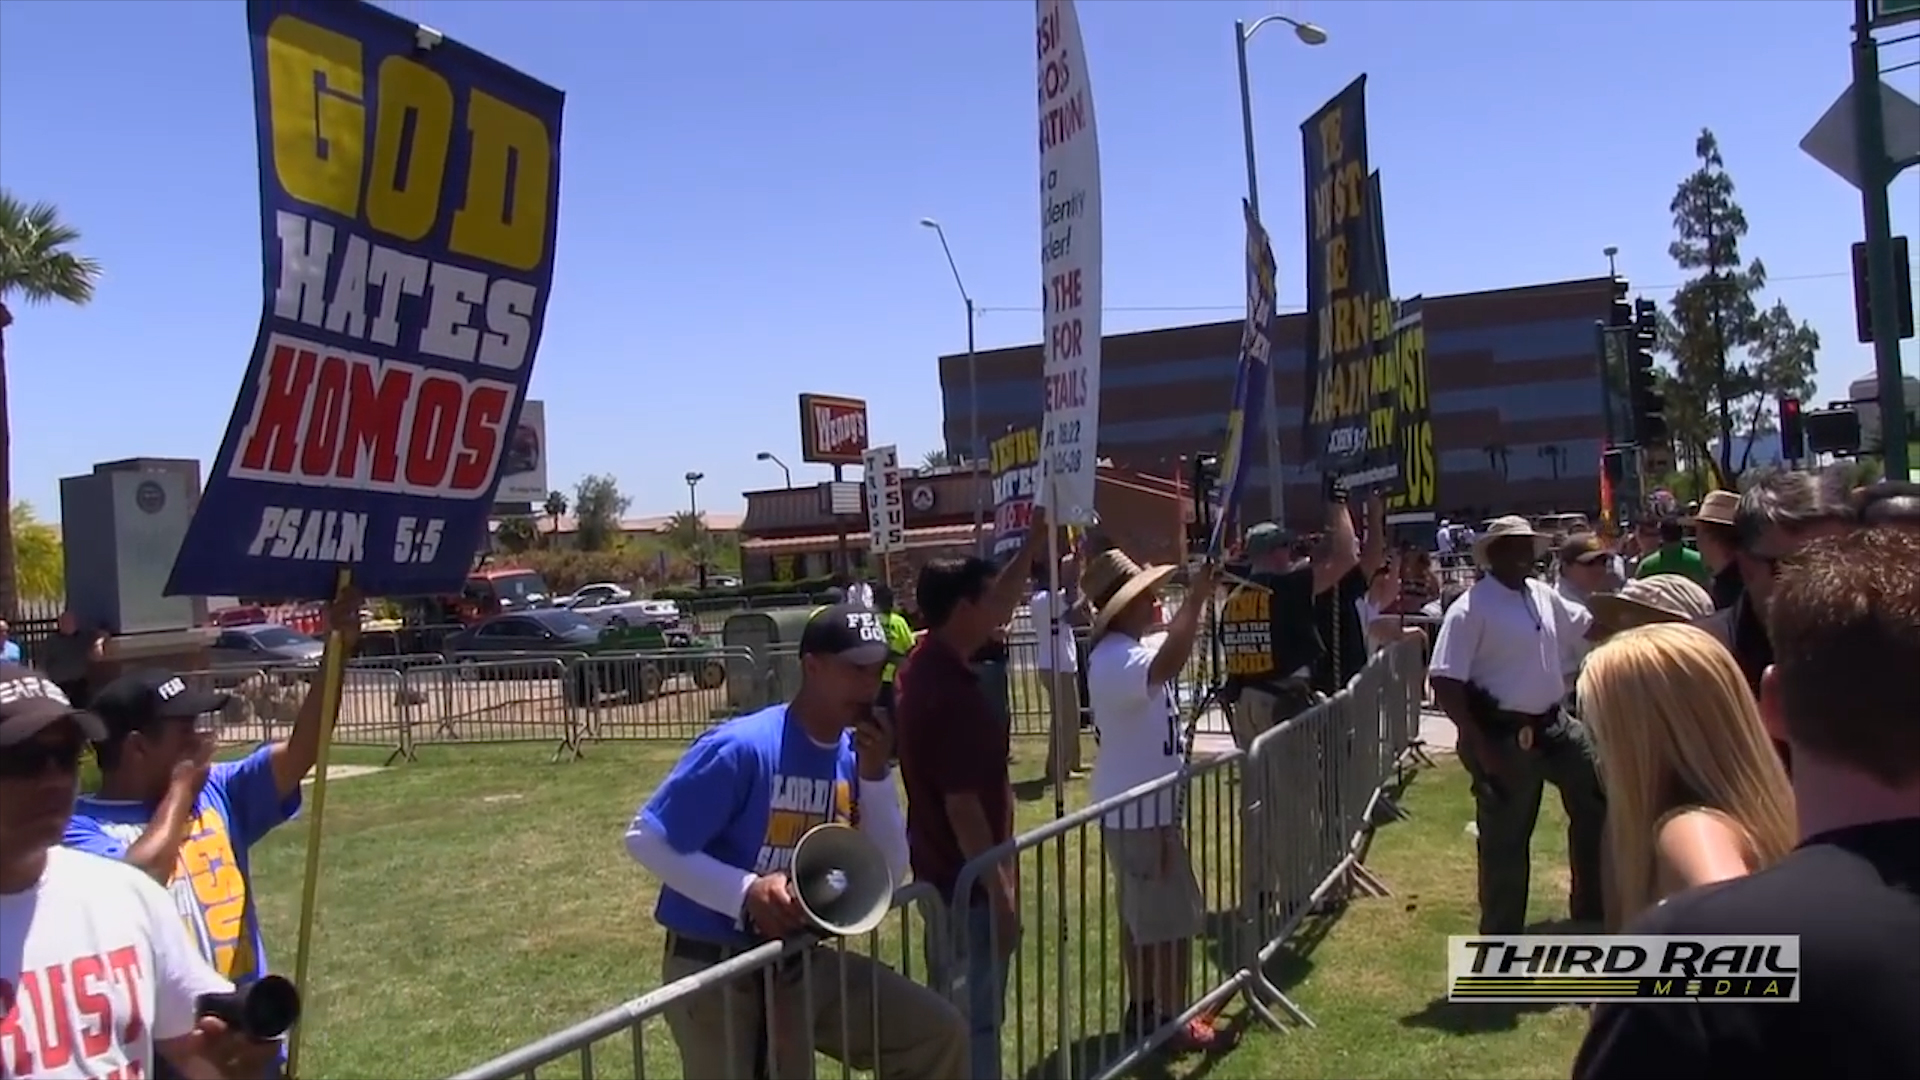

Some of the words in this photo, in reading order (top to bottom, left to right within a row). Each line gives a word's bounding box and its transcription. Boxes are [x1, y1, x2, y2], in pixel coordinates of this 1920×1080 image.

[266, 13, 551, 272] GOD
[273, 209, 538, 371] HATES
[1051, 268, 1082, 314] THE
[1052, 318, 1082, 363] FOR
[238, 342, 511, 492] HOMOS
[1044, 366, 1088, 412] ETAILS
[865, 456, 881, 546] TRUST
[883, 452, 901, 544] JESUS
[393, 516, 446, 563] 5:5
[770, 773, 831, 815] LORD
